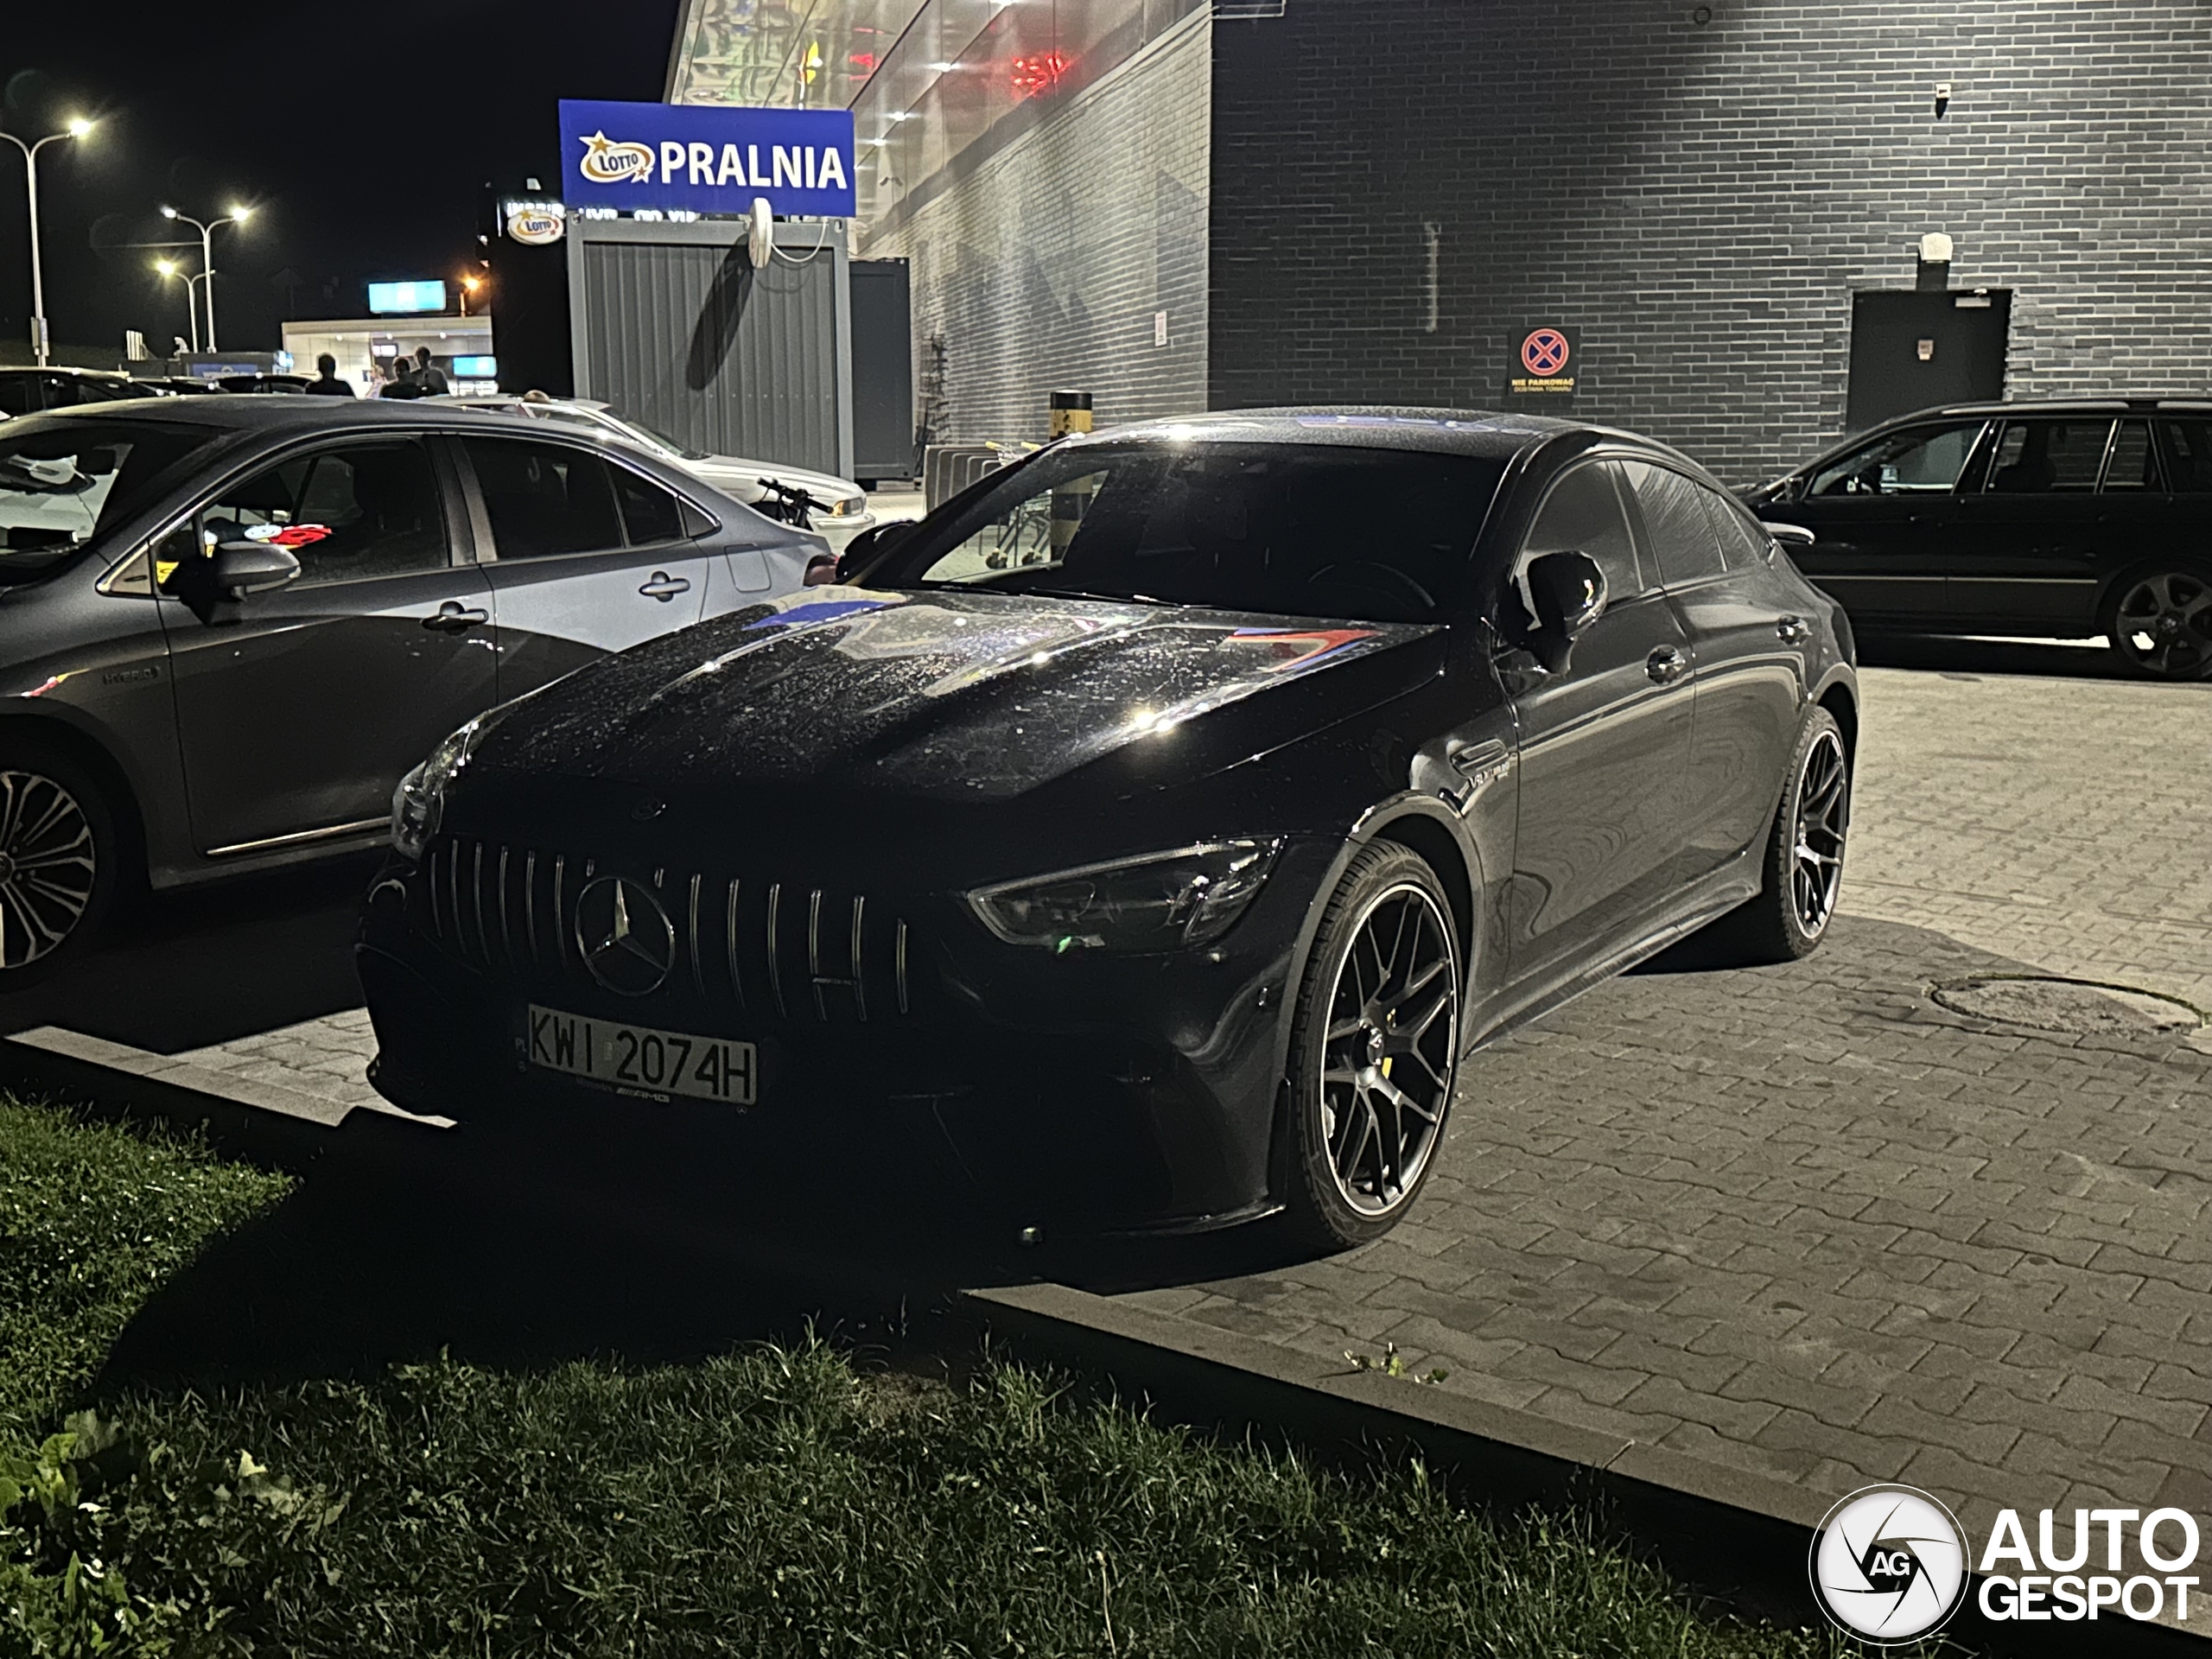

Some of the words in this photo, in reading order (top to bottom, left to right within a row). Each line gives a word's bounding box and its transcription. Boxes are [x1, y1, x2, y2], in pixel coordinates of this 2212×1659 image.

[599, 153, 639, 172] LOTTO
[660, 142, 848, 189] PRALNIA
[525, 220, 552, 232] LOTTO
[531, 1010, 593, 1073] KWI
[615, 1029, 750, 1100] 2074H
